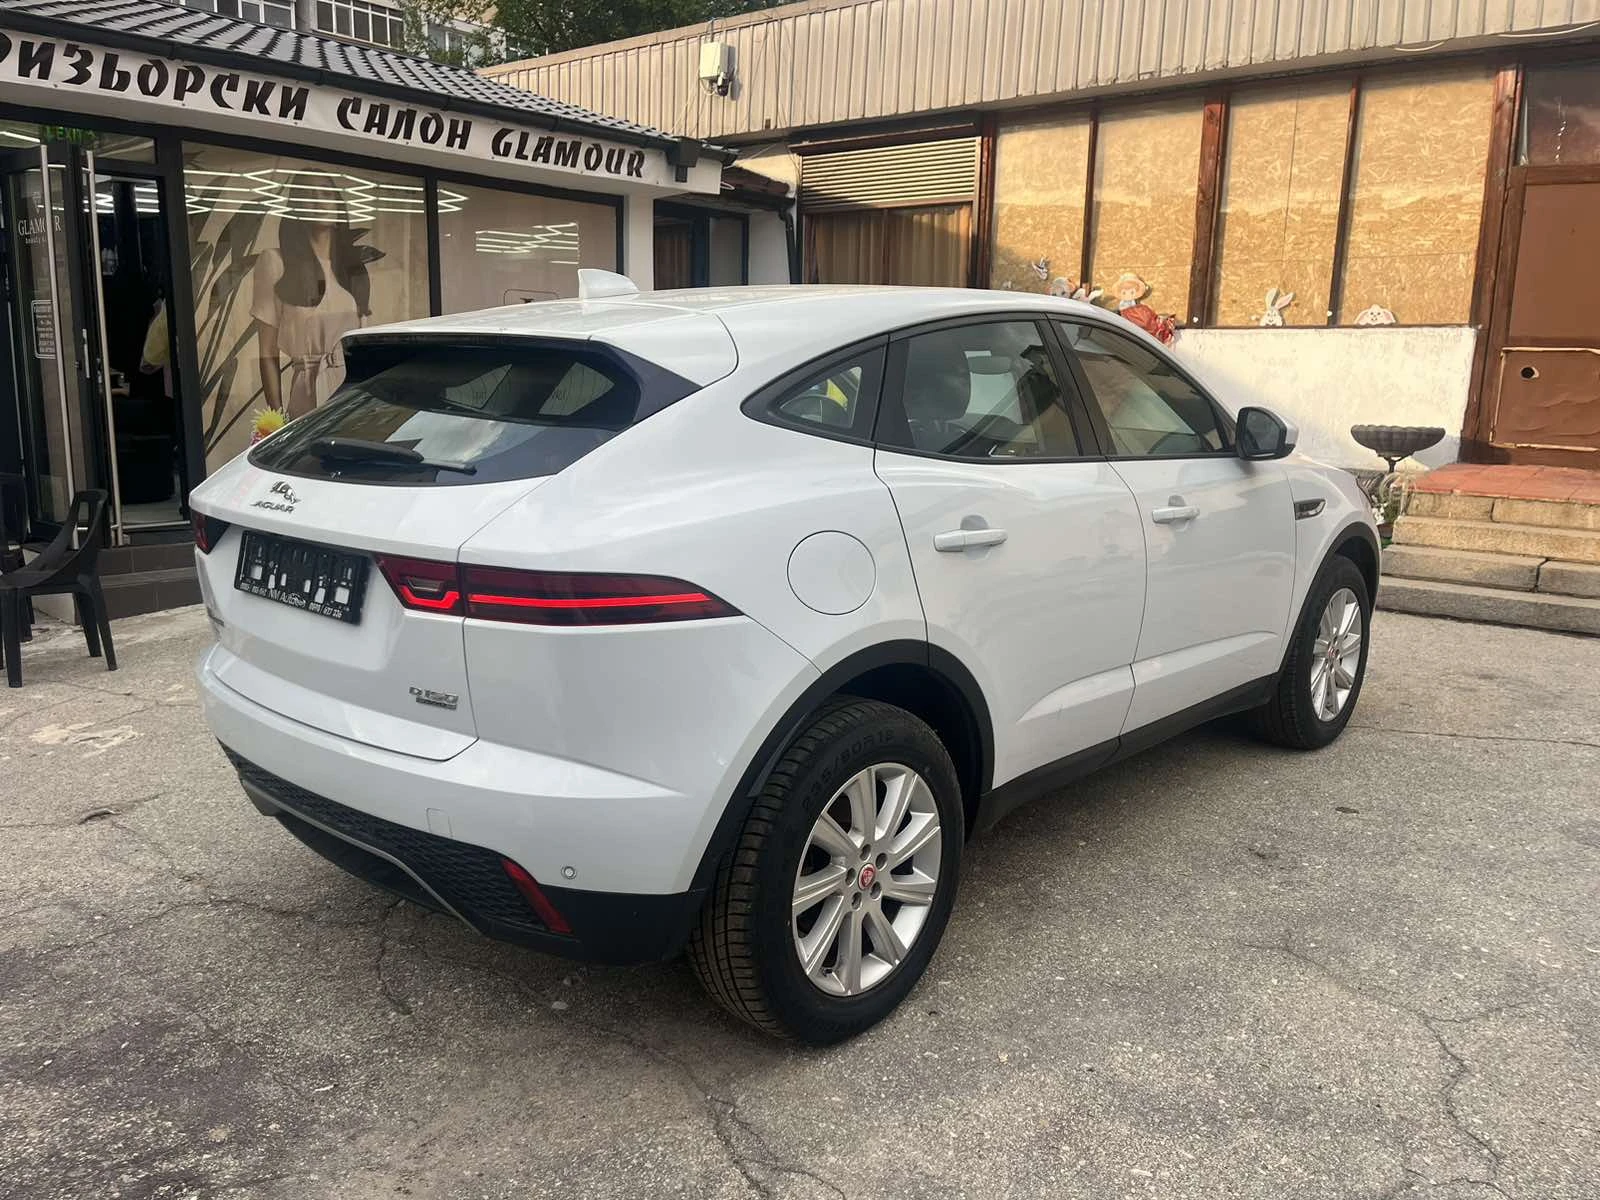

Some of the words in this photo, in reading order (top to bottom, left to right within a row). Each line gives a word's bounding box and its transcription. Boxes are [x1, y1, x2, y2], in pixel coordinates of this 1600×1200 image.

[337, 97, 472, 150] САЛОН
[491, 127, 645, 178] GLAMOUR
[18, 215, 62, 235] GLAMR
